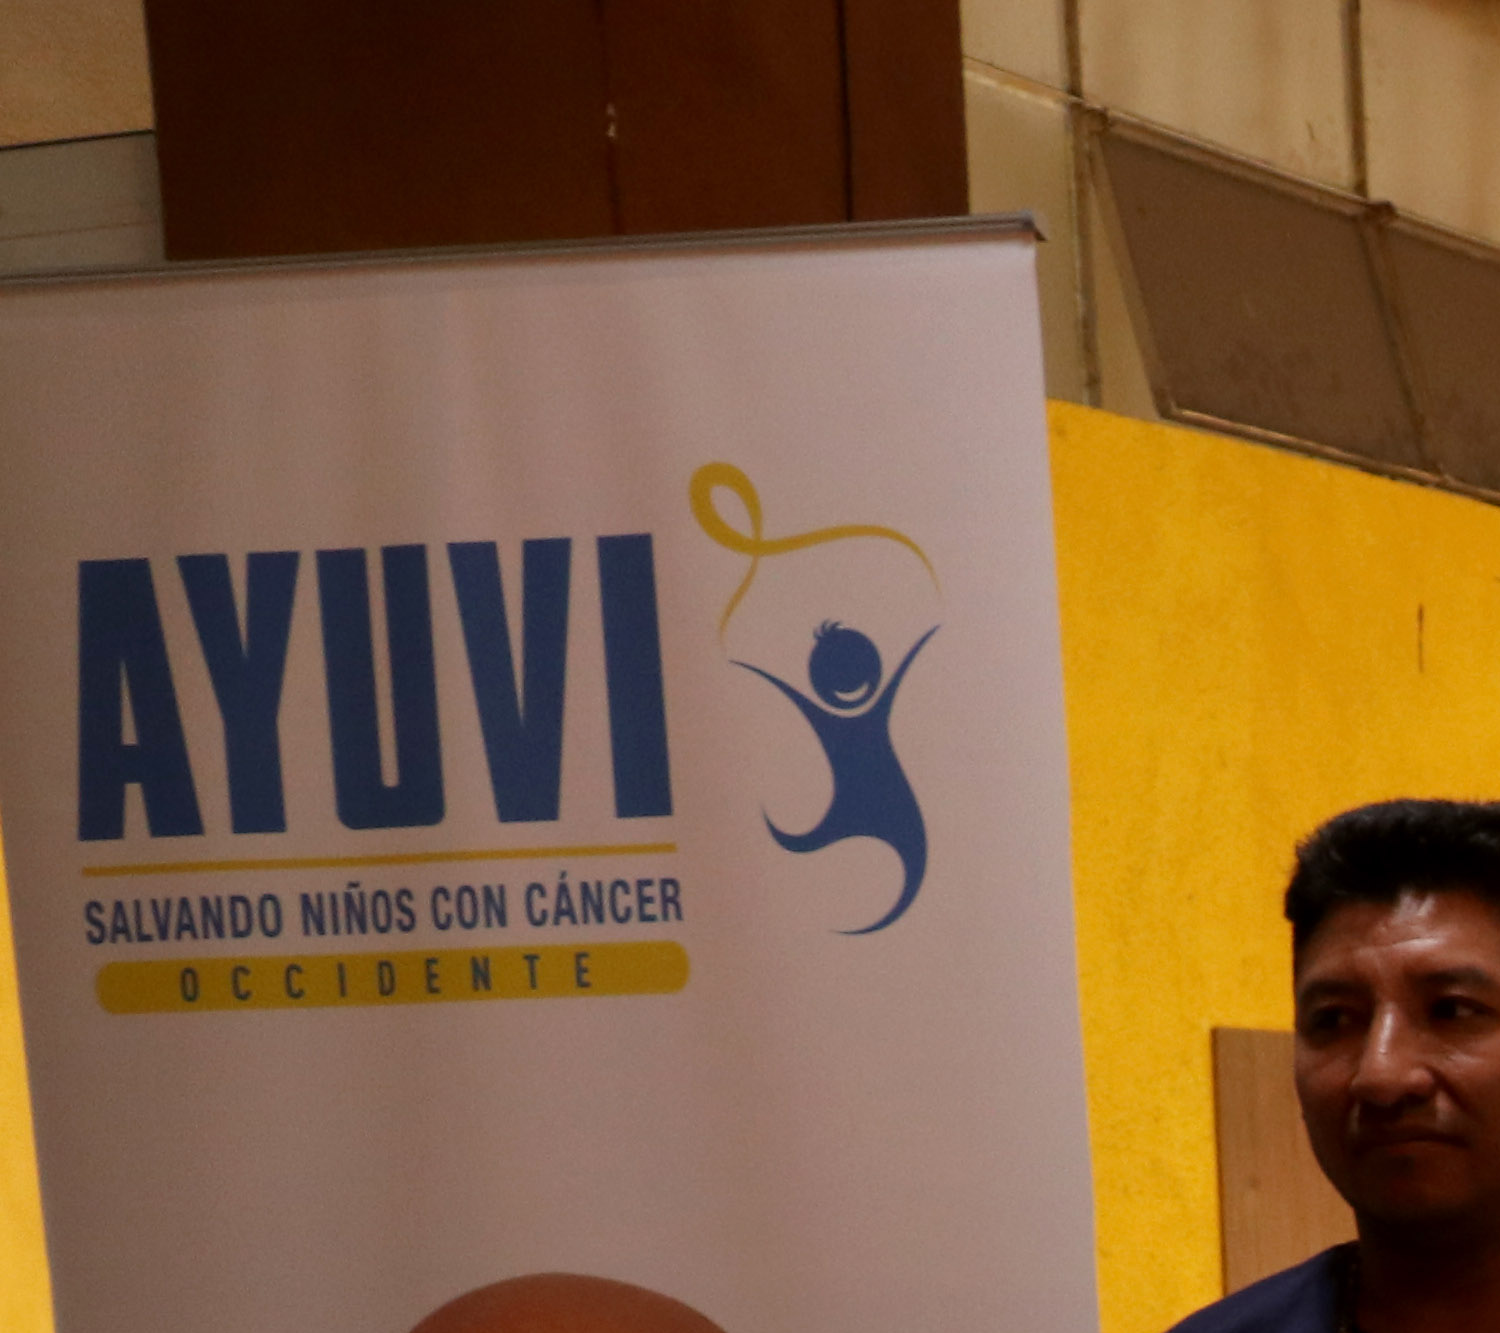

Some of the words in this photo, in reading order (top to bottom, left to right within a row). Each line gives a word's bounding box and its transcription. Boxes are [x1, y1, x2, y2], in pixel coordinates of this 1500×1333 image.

[77, 533, 675, 841] AYUVI
[84, 885, 284, 946] SALVANDO
[300, 874, 417, 940] NIÑOS
[430, 875, 509, 931] CON
[524, 868, 685, 926] CÁNCER
[179, 950, 595, 1002] OCCIDENTE
